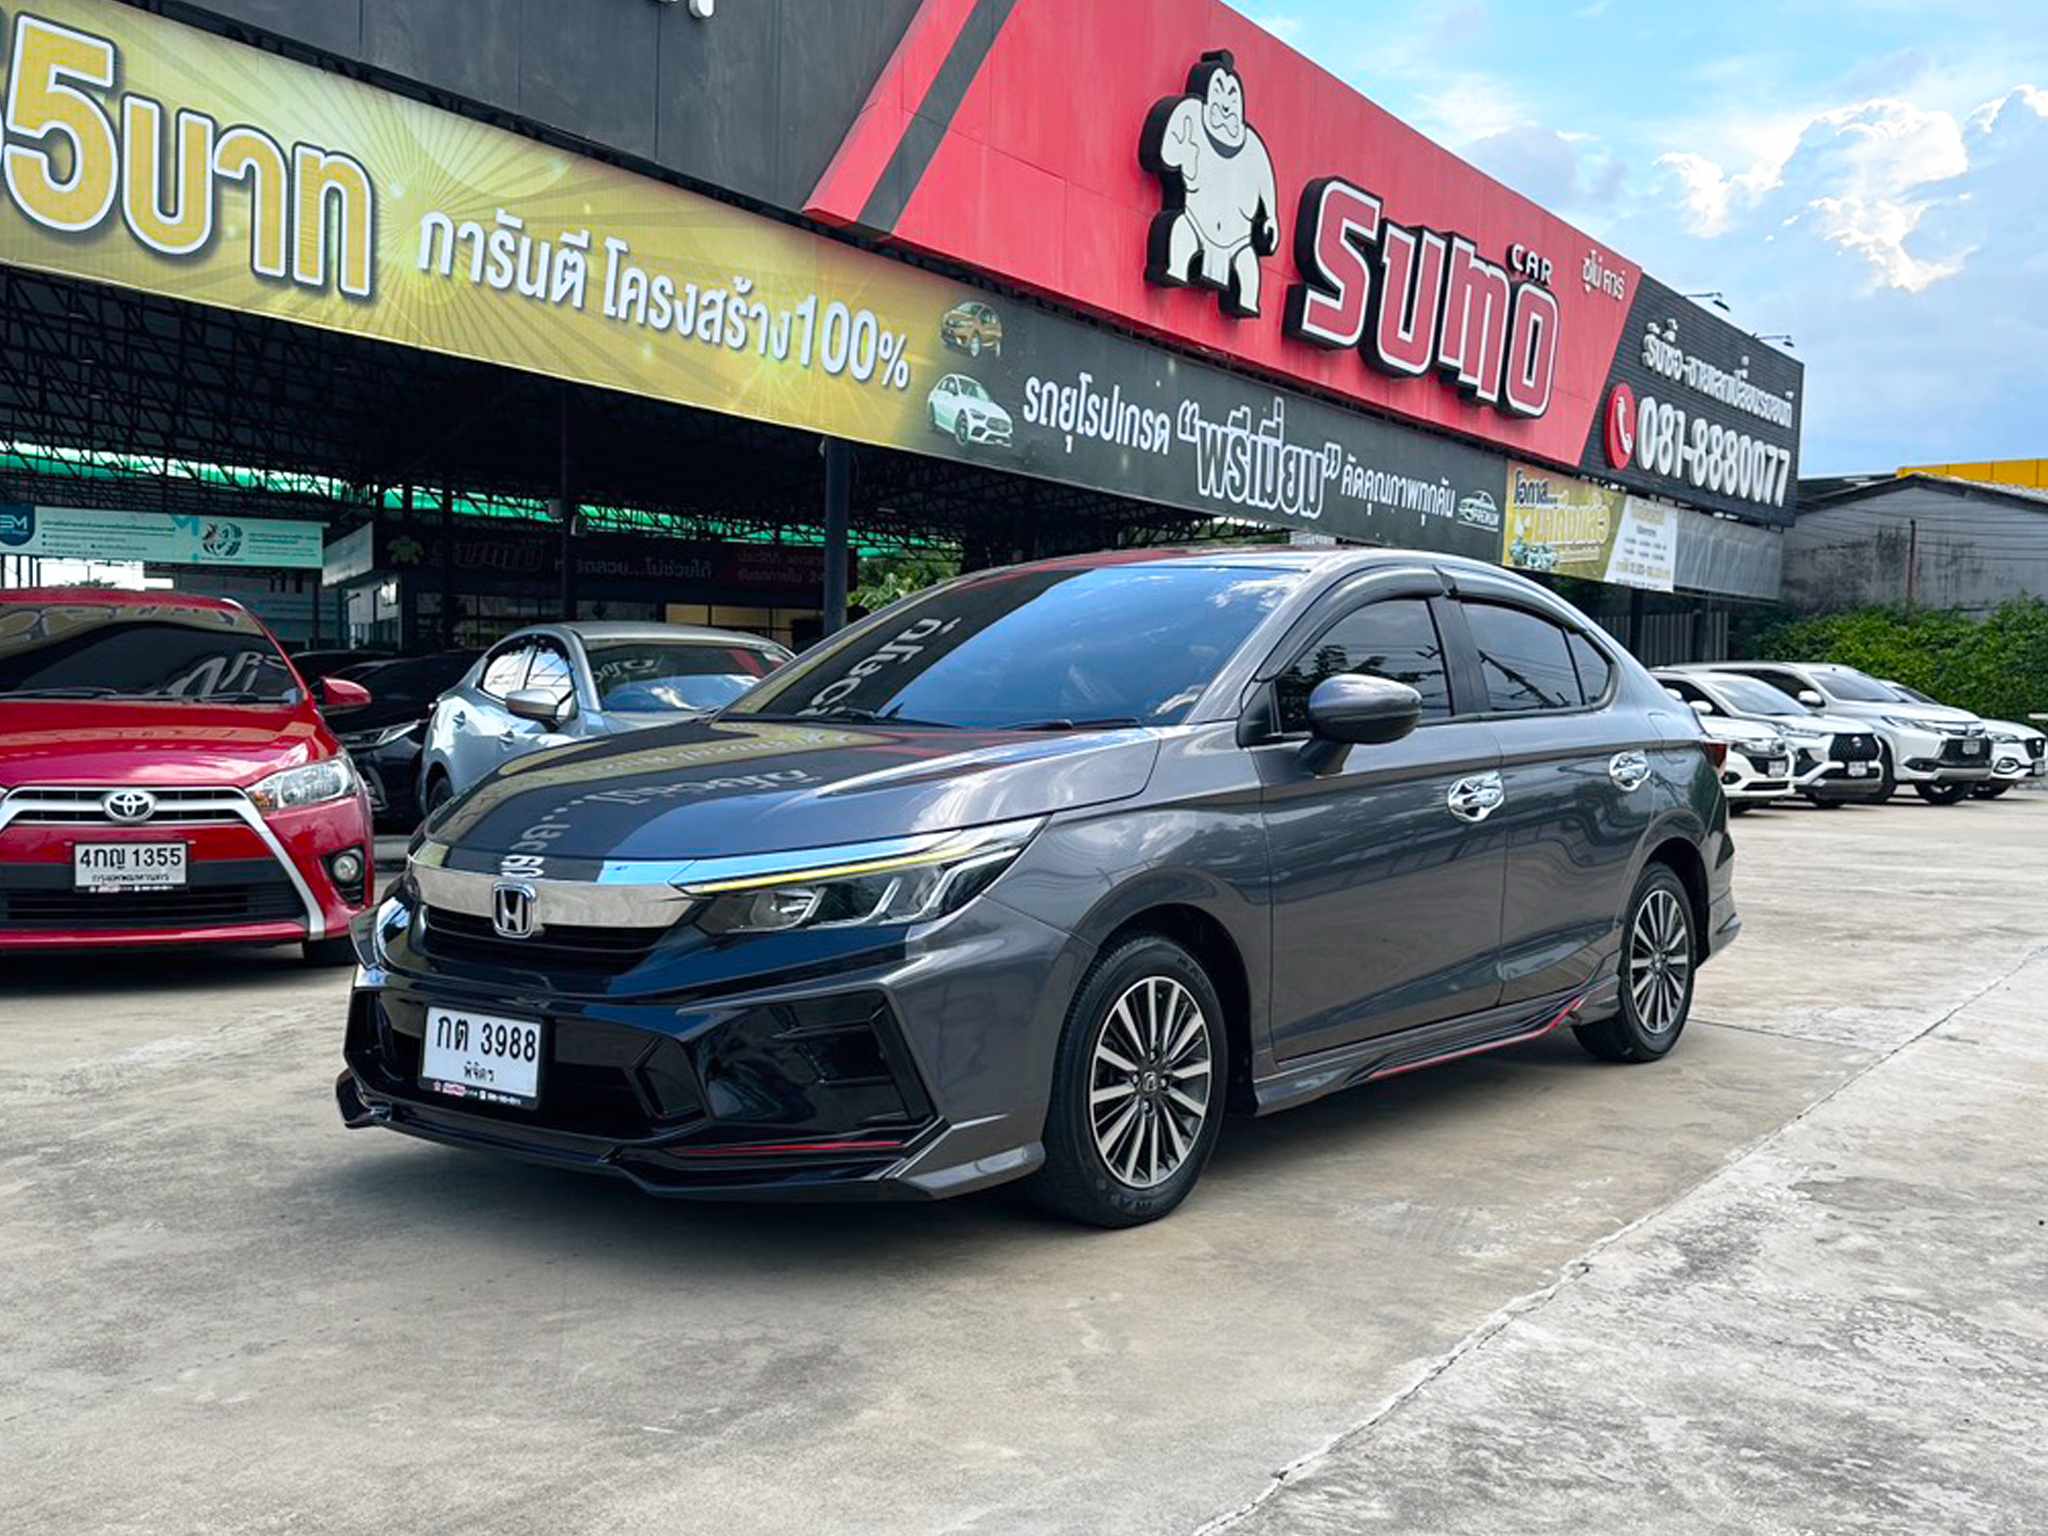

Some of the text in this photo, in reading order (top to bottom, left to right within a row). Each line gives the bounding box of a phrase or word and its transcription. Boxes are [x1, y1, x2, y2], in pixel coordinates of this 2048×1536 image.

[417, 207, 591, 309] การันตี
[1510, 243, 1554, 286] CAR
[1023, 372, 1171, 455] รถยุโรปเกรด
[1636, 395, 1791, 508] 081-8880077
[80, 847, 182, 870] 4กญ 1355
[480, 1022, 536, 1062] 3988
